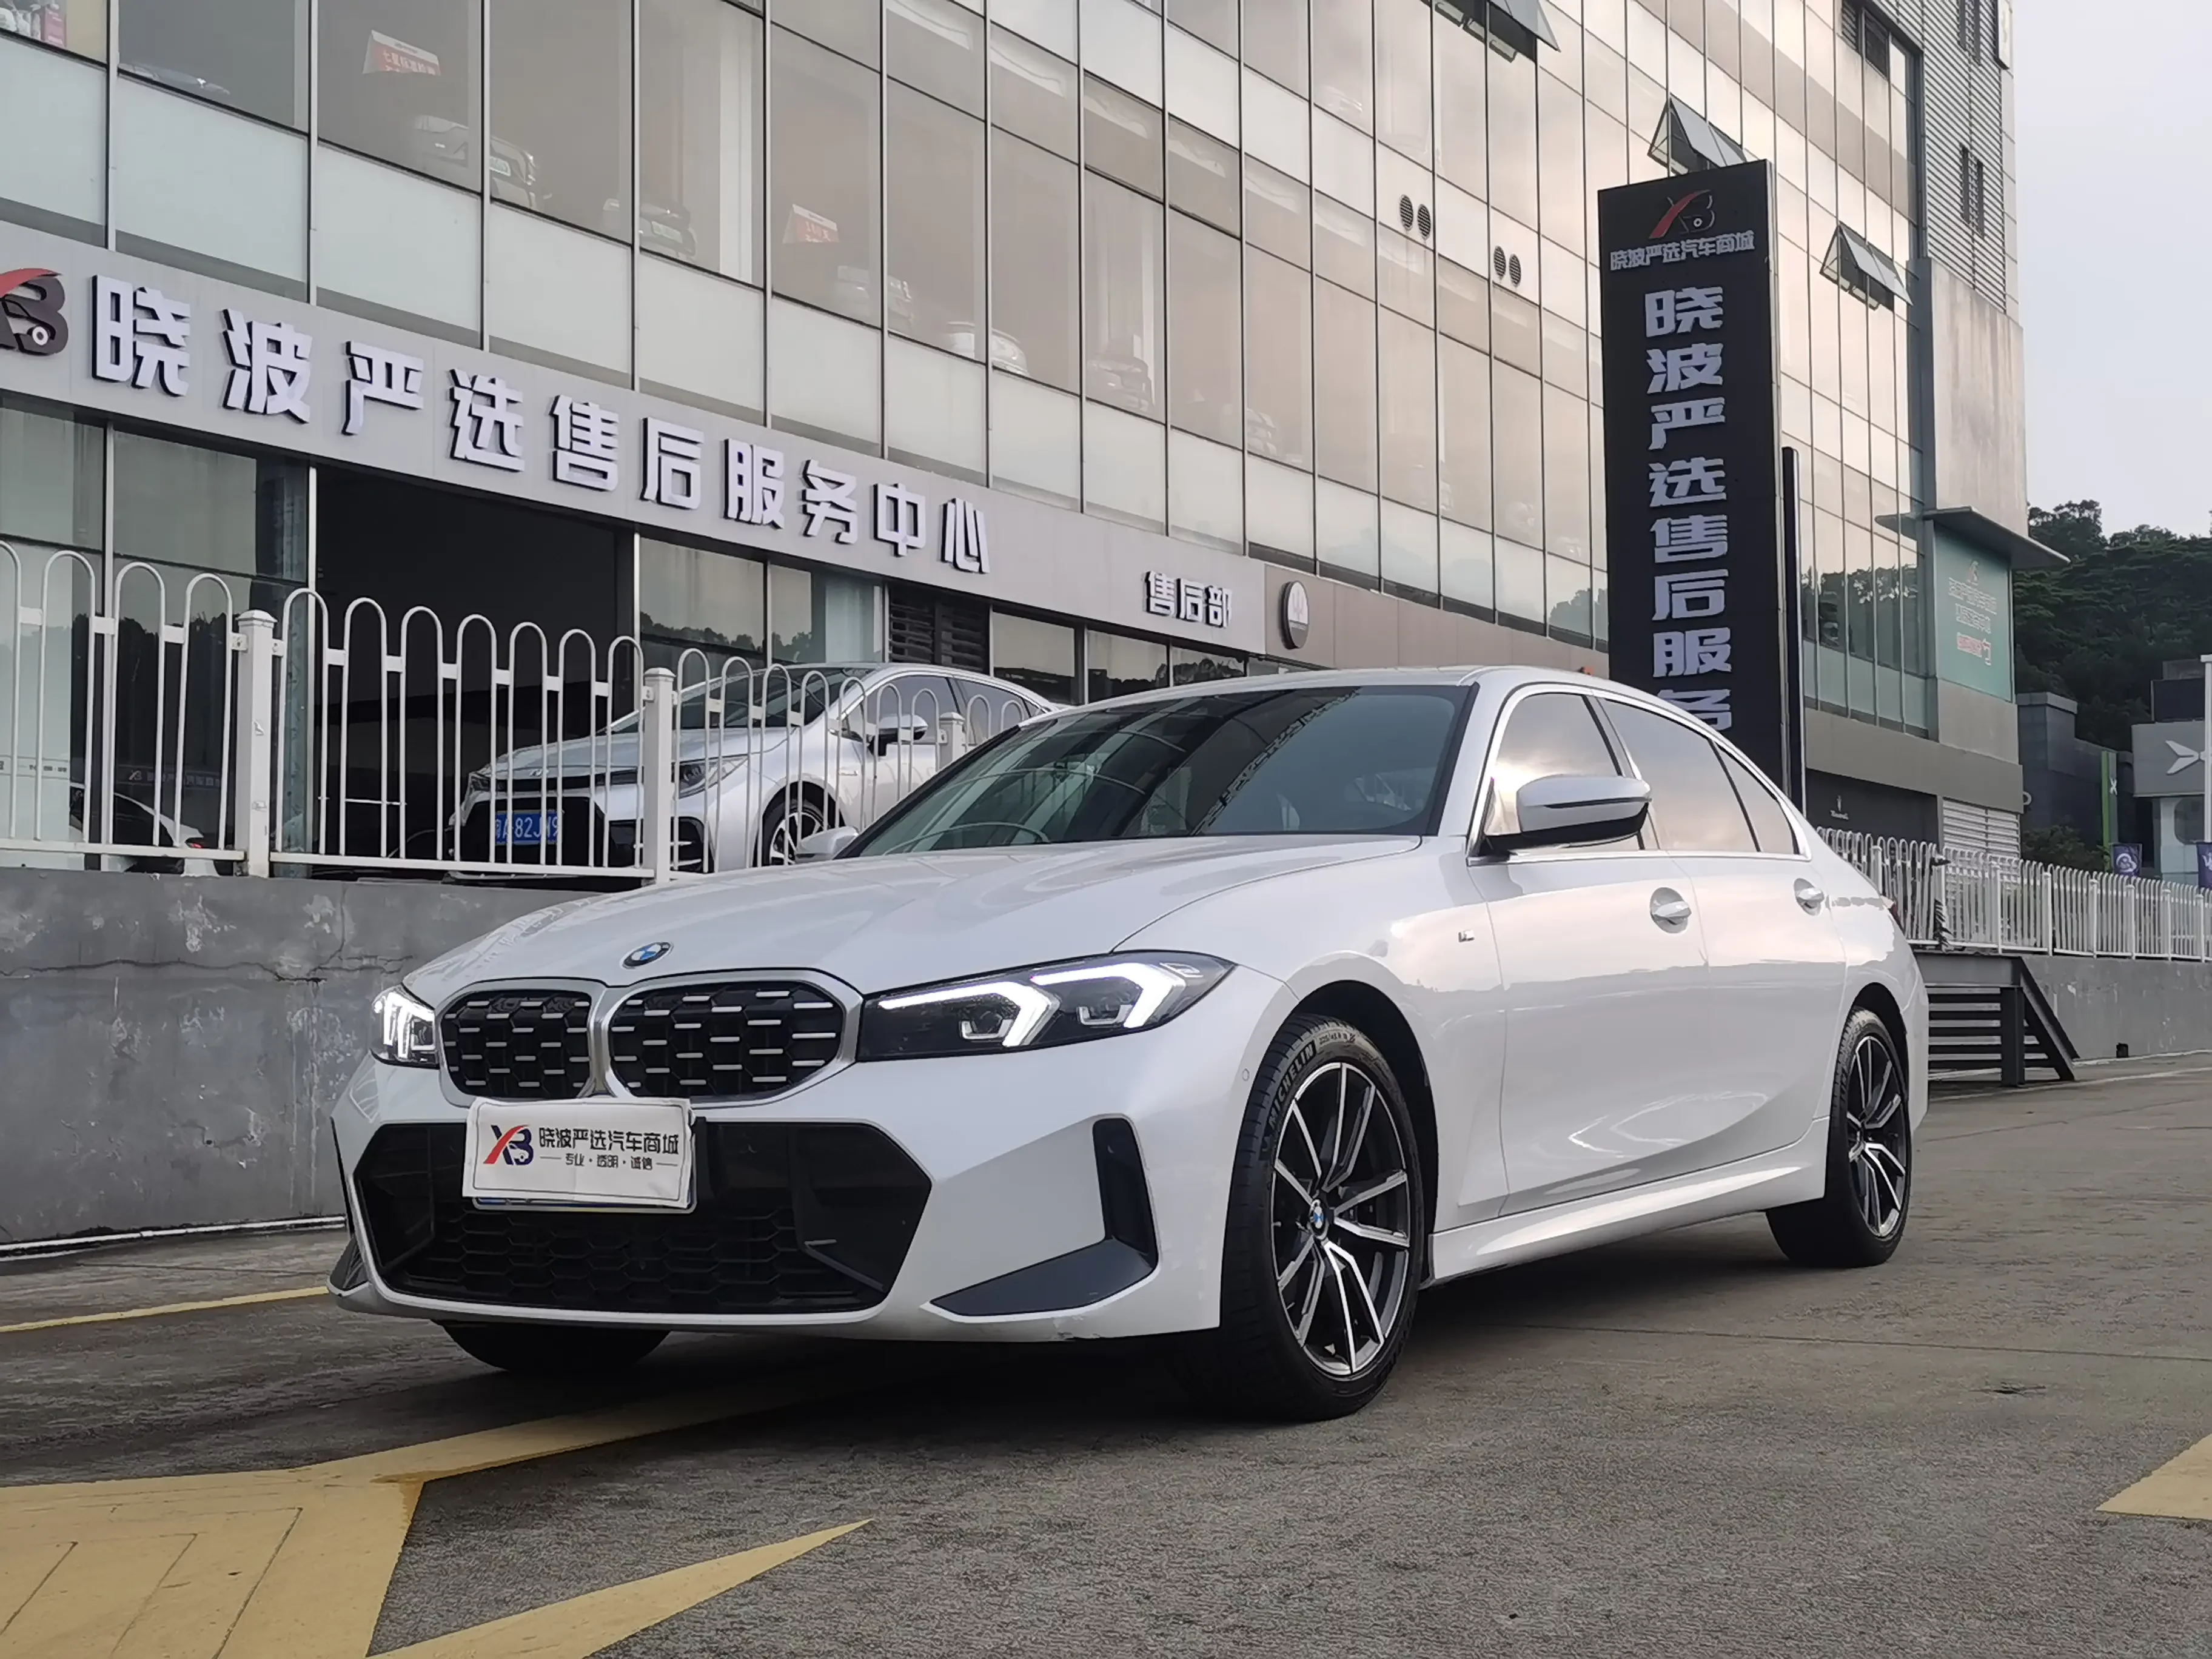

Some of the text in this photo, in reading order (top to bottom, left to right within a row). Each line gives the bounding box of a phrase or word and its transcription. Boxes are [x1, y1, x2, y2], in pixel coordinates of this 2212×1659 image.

[1610, 229, 1755, 271] 晓波严选汽车商城
[92, 275, 991, 574] 晓波严选售后服务中心
[1144, 571, 1232, 629] 售后部
[1268, 1042, 1316, 1131] MICHELIN
[538, 1127, 679, 1155] 晓波严选汽车商城
